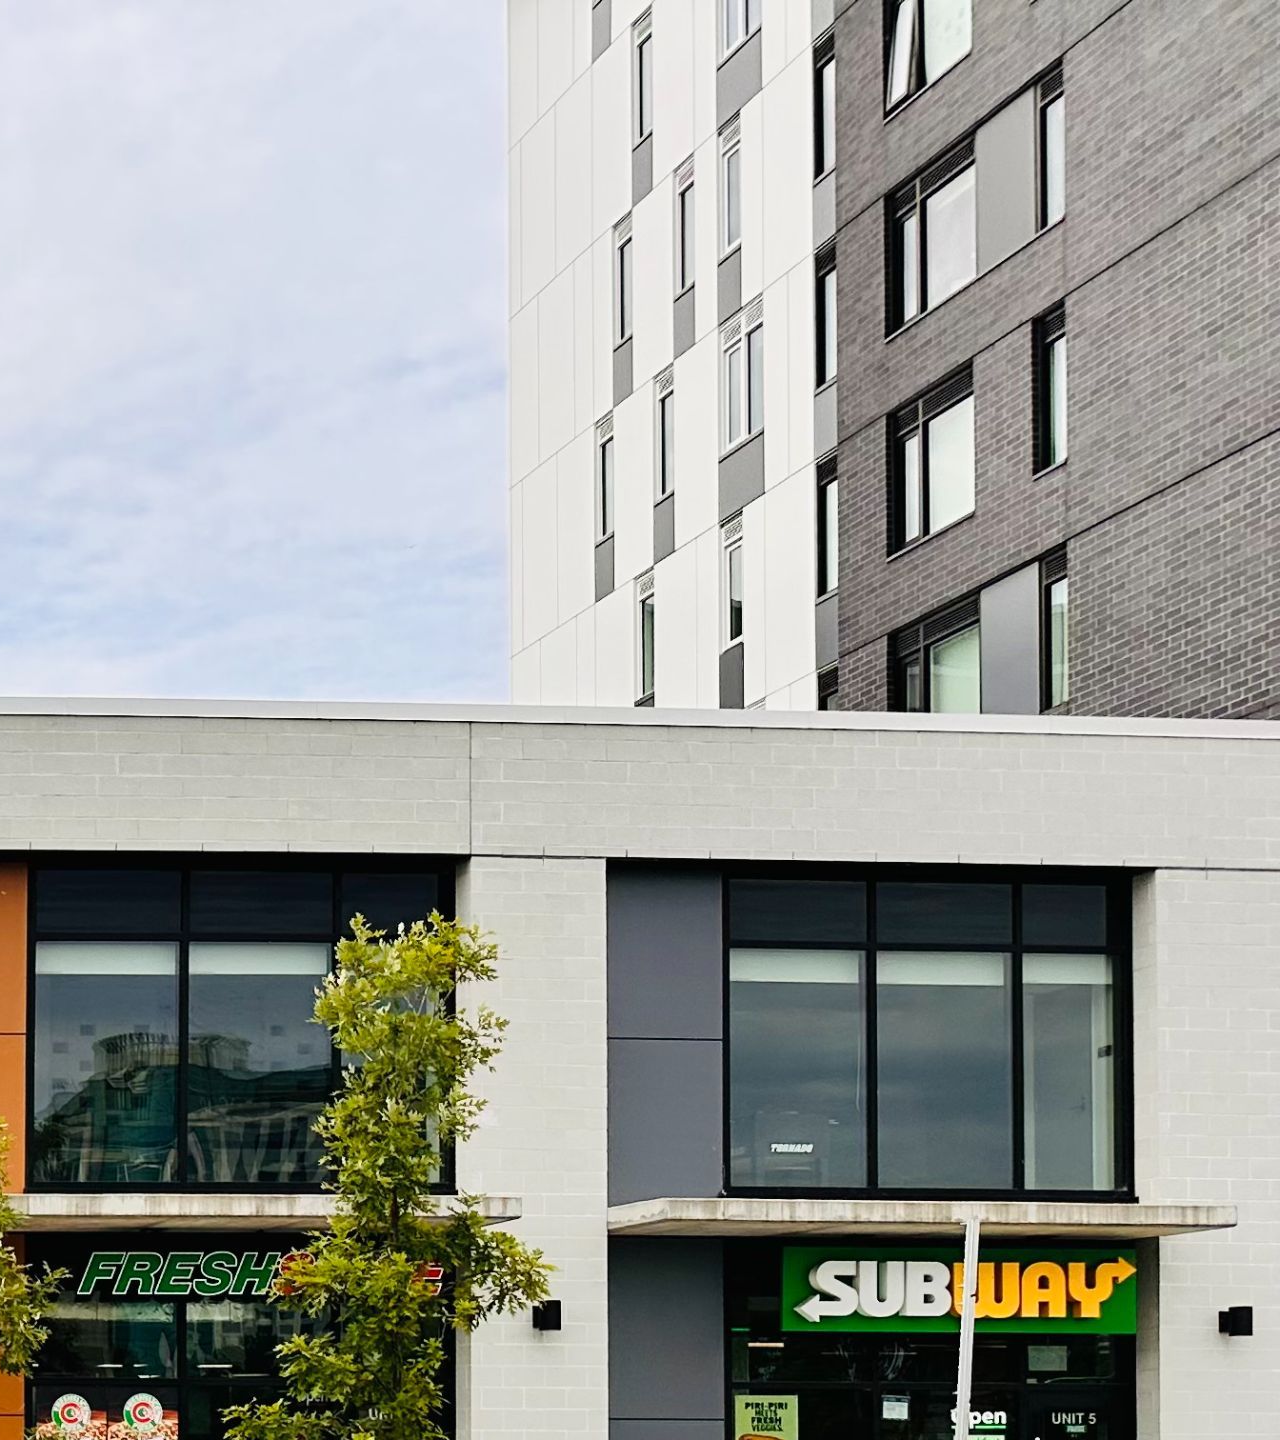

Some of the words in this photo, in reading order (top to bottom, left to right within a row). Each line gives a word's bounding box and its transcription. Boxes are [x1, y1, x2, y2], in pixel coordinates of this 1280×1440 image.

[770, 1143, 814, 1153] TORNADO
[793, 1256, 1137, 1322] SUBWAY
[744, 1402, 788, 1410] PIRI-PIRI
[751, 1416, 782, 1425] FRESH
[1052, 1412, 1085, 1425] UNIT
[1088, 1412, 1097, 1425] 5
